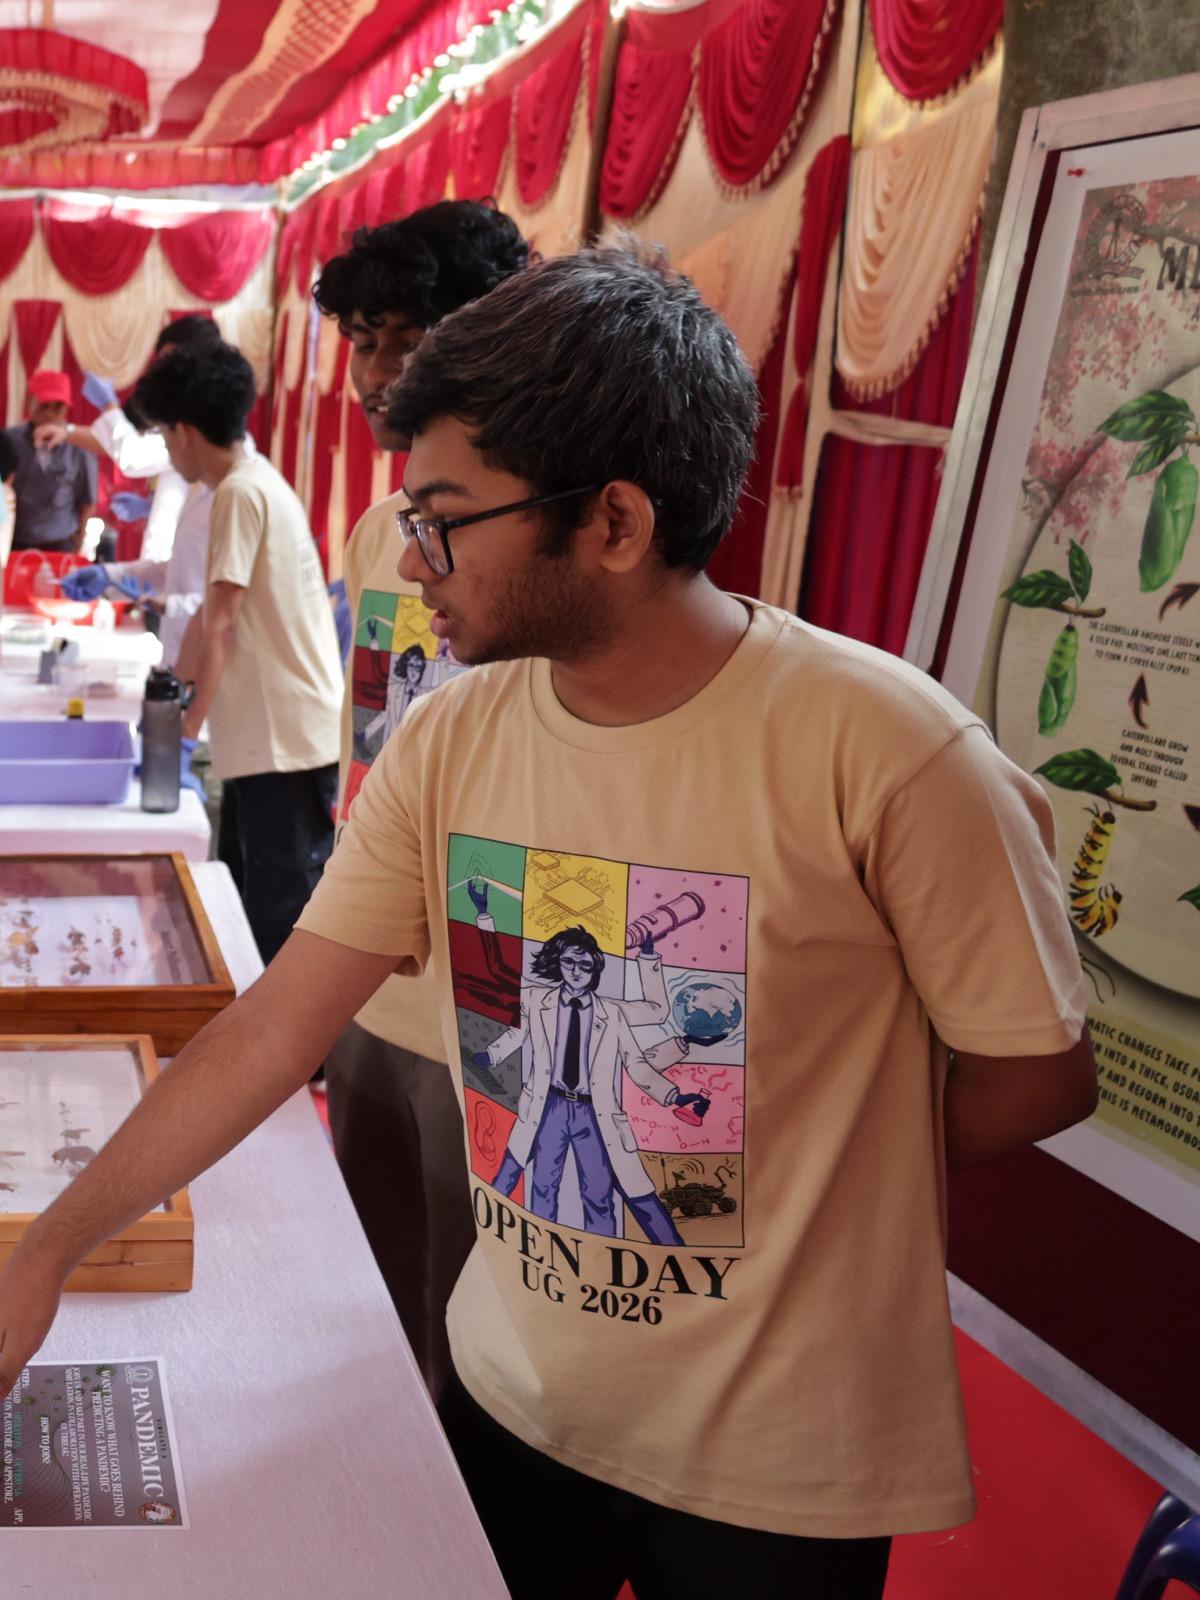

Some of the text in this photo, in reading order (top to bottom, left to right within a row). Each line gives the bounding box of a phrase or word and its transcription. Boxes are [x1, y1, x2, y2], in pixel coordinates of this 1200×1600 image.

[1088, 1018, 1116, 1039] MATIC
[1118, 1032, 1163, 1061] CHANGES
[1165, 1053, 1190, 1075] TAKE
[1104, 1047, 1128, 1066] INTO
[1129, 1059, 1136, 1071] A
[1173, 1081, 1200, 1105] USUA
[1106, 1069, 1127, 1088] AND
[1128, 1080, 1167, 1109] REFORM
[1169, 1101, 1194, 1123] INTO
[1119, 1098, 1129, 1112] IS
[473, 1187, 741, 1300] OPEN DAY
[520, 1257, 663, 1326] UG 2026
[4, 1412, 12, 1448] PLAYSTORE
[5, 1401, 12, 1412] ON
[76, 1417, 85, 1432] PART
[5, 1450, 13, 1464] AND
[39, 1417, 50, 1464] HOW TO JOIN?
[101, 1370, 125, 1516] WANT TO KNOW WHAT GOES BEHIND
[130, 1387, 164, 1497] PANDEMIC
[156, 1419, 166, 1452] SIMULATE
[73, 1482, 82, 1520] OPERATION
